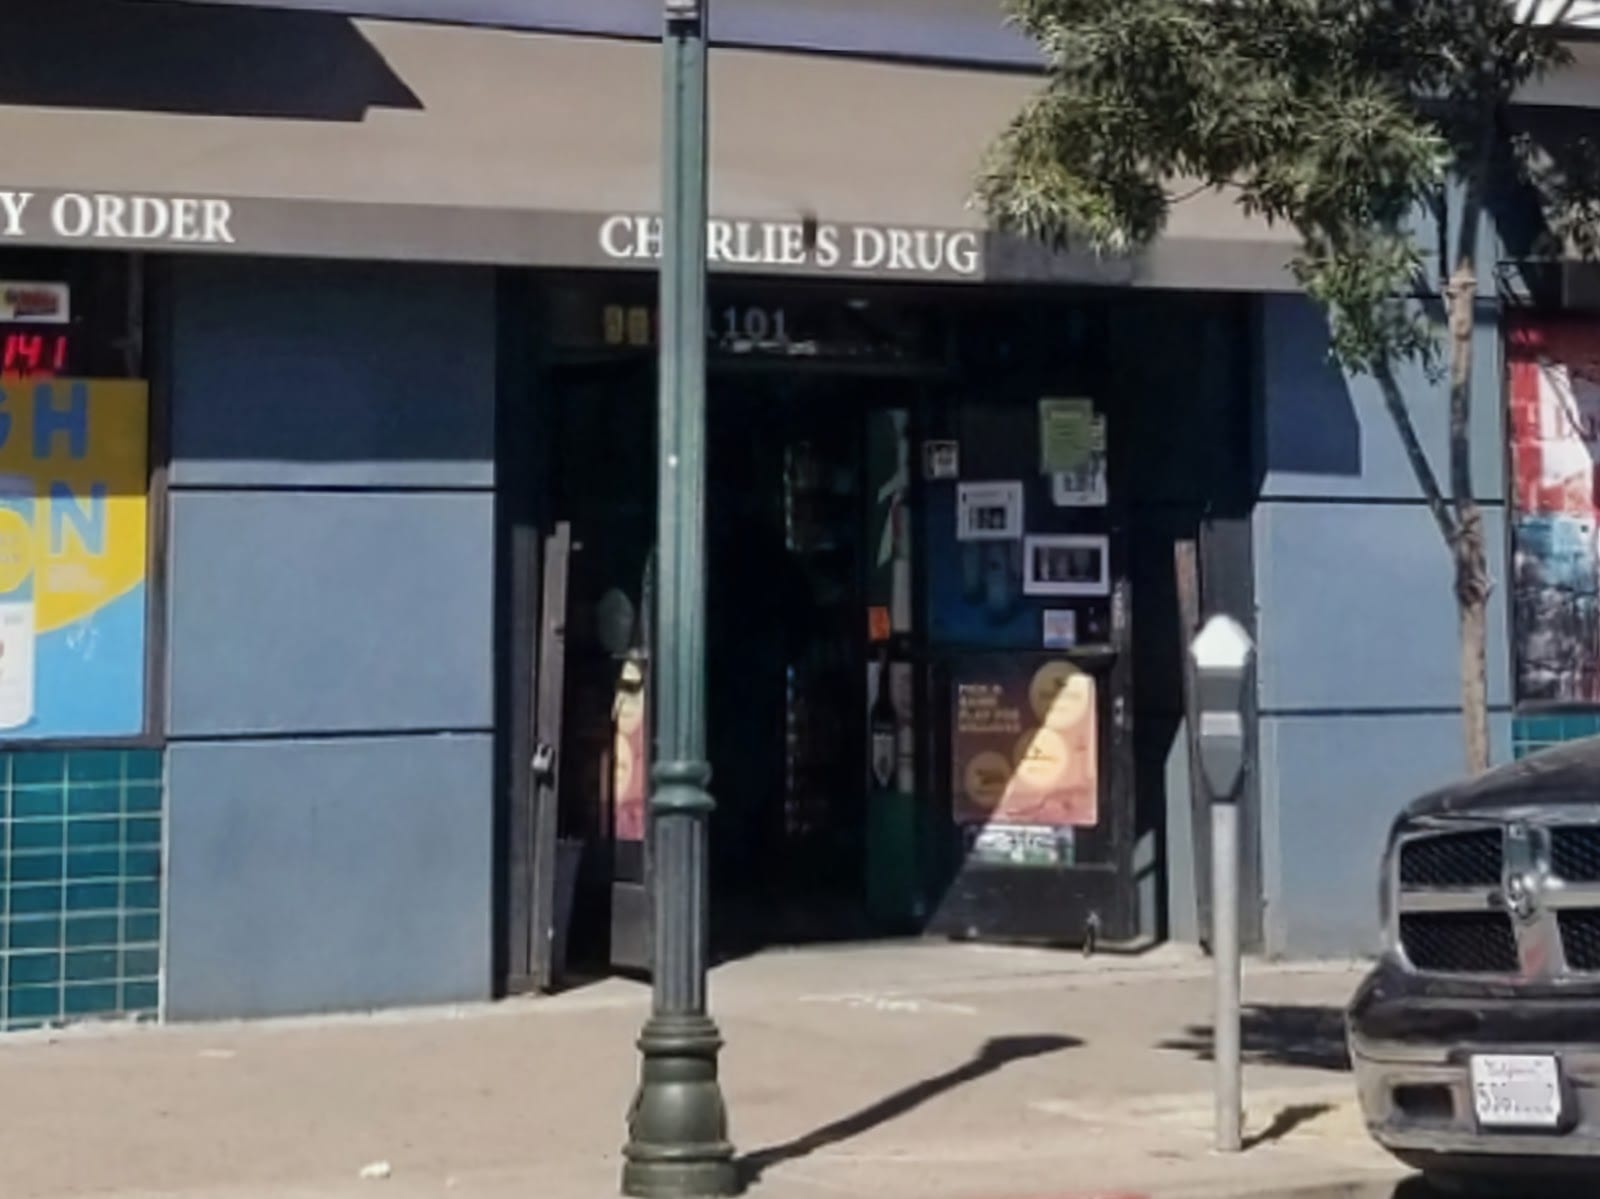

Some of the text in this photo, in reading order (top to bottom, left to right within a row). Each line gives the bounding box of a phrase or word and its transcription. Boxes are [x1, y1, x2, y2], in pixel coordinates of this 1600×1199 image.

[53, 193, 235, 243] ORDER
[598, 216, 979, 274] CHRLIES DRUG
